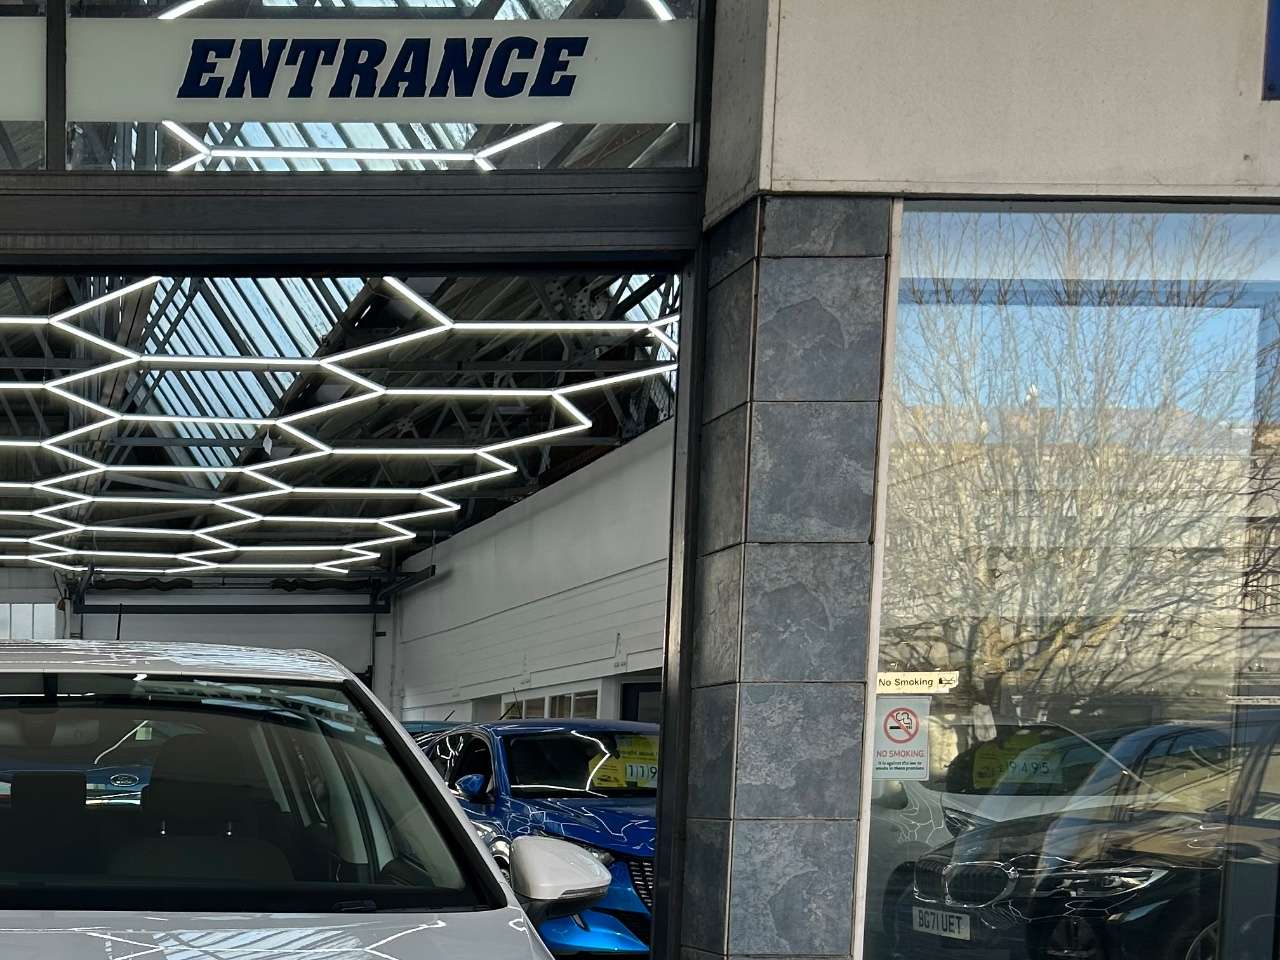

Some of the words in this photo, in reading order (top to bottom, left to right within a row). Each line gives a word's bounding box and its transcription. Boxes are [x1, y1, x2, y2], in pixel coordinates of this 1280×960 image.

[176, 36, 589, 100] ENTRANCE
[878, 678, 892, 687] No
[894, 677, 934, 688] Smoking
[876, 750, 888, 758] NO
[889, 750, 924, 758] SMOKING
[941, 913, 962, 935] UET
